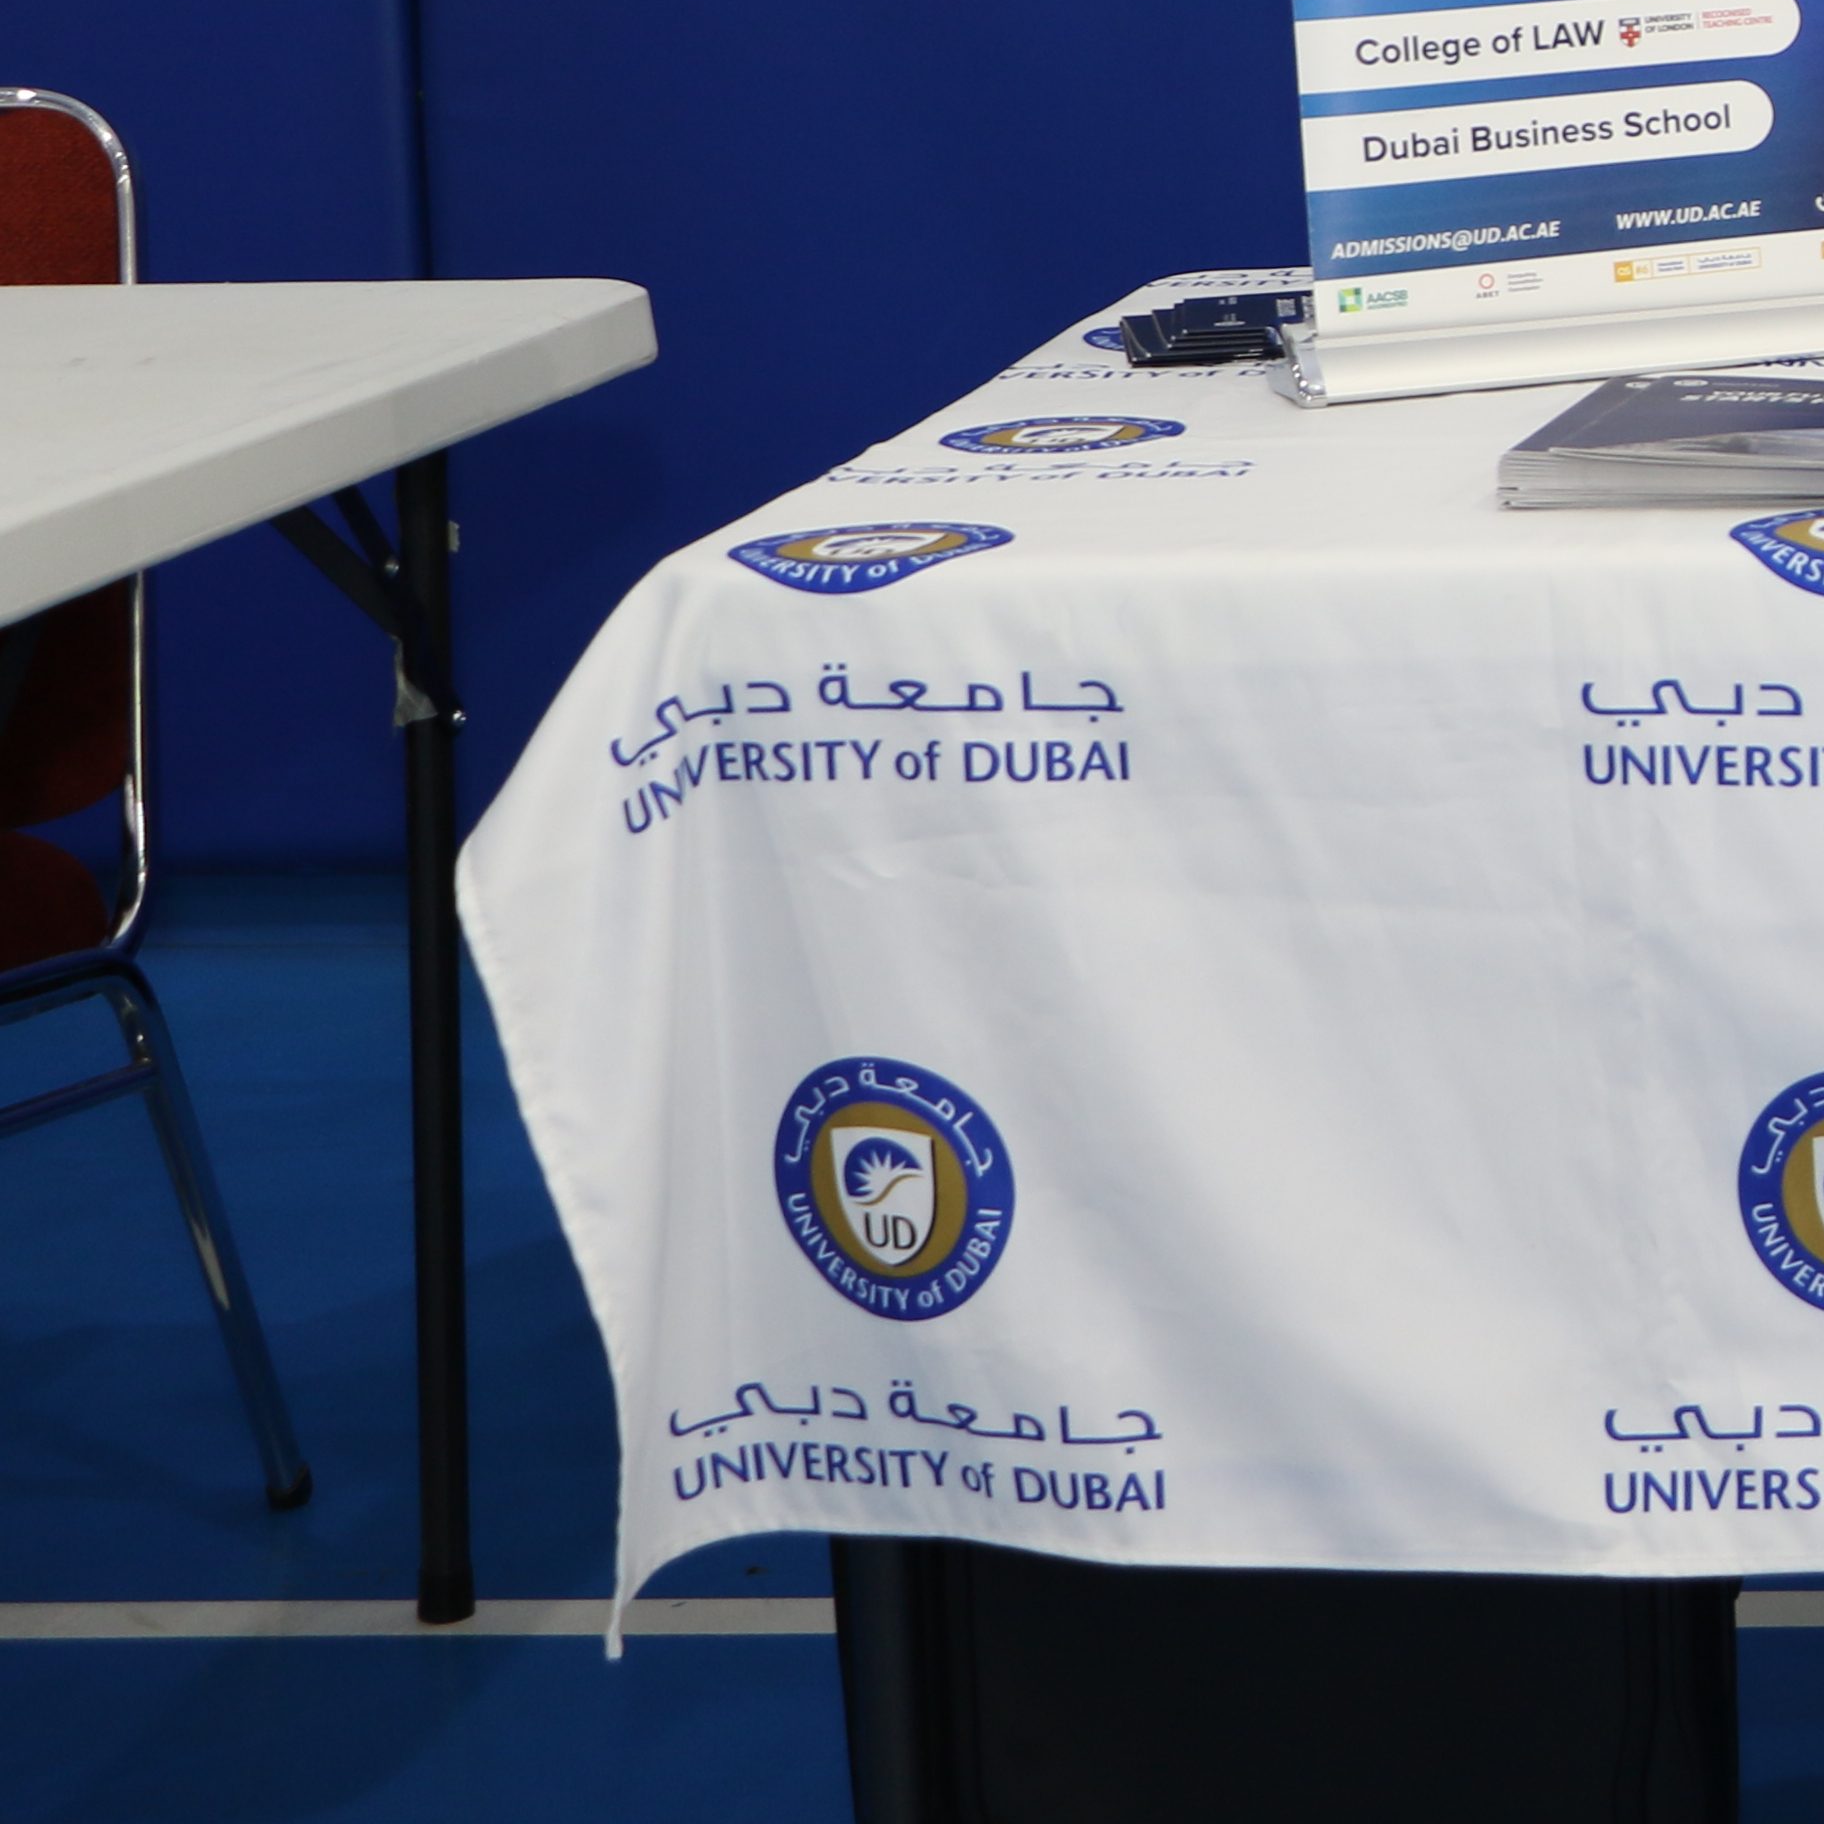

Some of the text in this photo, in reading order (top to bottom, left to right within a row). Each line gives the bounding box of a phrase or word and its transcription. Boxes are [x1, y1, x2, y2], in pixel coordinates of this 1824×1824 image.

[1644, 13, 1691, 23] UNIVERSITY
[1658, 23, 1694, 32] LONDON
[1355, 20, 1605, 66] College of LAW
[1363, 104, 1732, 163] Dubai Business School
[1615, 200, 1762, 231] WWW.UD.AC.AE
[1331, 220, 1561, 260] ADMISSIONS@UD.AC.AE
[1367, 289, 1408, 303] AACSB
[867, 558, 899, 578] of
[611, 663, 1124, 767] جامعة دبي
[1582, 678, 1802, 727] دبي
[623, 740, 1130, 834] UNIVERSITY of DUBAI
[785, 1062, 993, 1177] جامعة دبي
[788, 1193, 1002, 1311] UNIVERSITY of DUBAI
[863, 1212, 916, 1250] UD
[670, 1380, 1162, 1455] جامعة دبي
[1604, 1404, 1821, 1452] دبي
[674, 1442, 1165, 1512] UNIVERSITY of DUBAI
